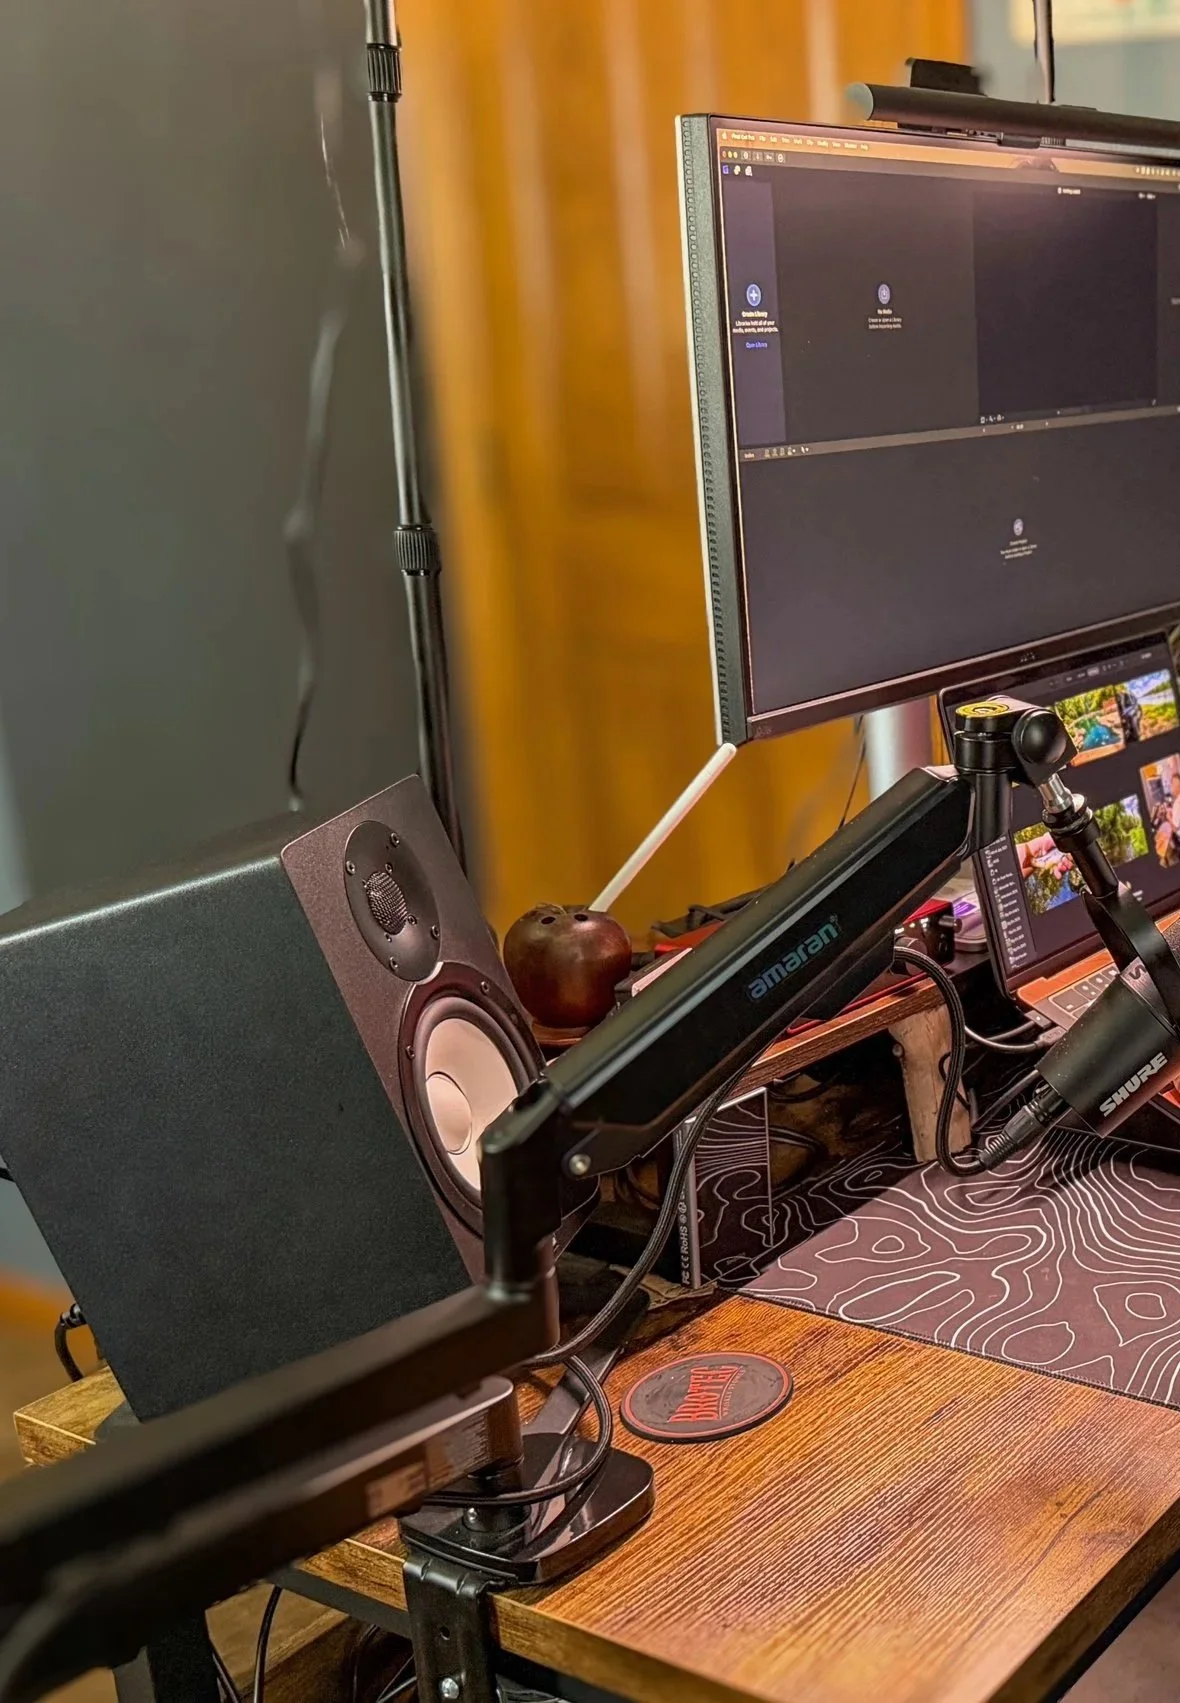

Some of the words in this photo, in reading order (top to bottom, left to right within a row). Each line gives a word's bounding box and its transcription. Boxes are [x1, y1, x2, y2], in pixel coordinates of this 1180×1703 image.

[748, 923, 839, 999] amaran
[1100, 1052, 1168, 1118] SHURE
[680, 1225, 688, 1255] RoHS
